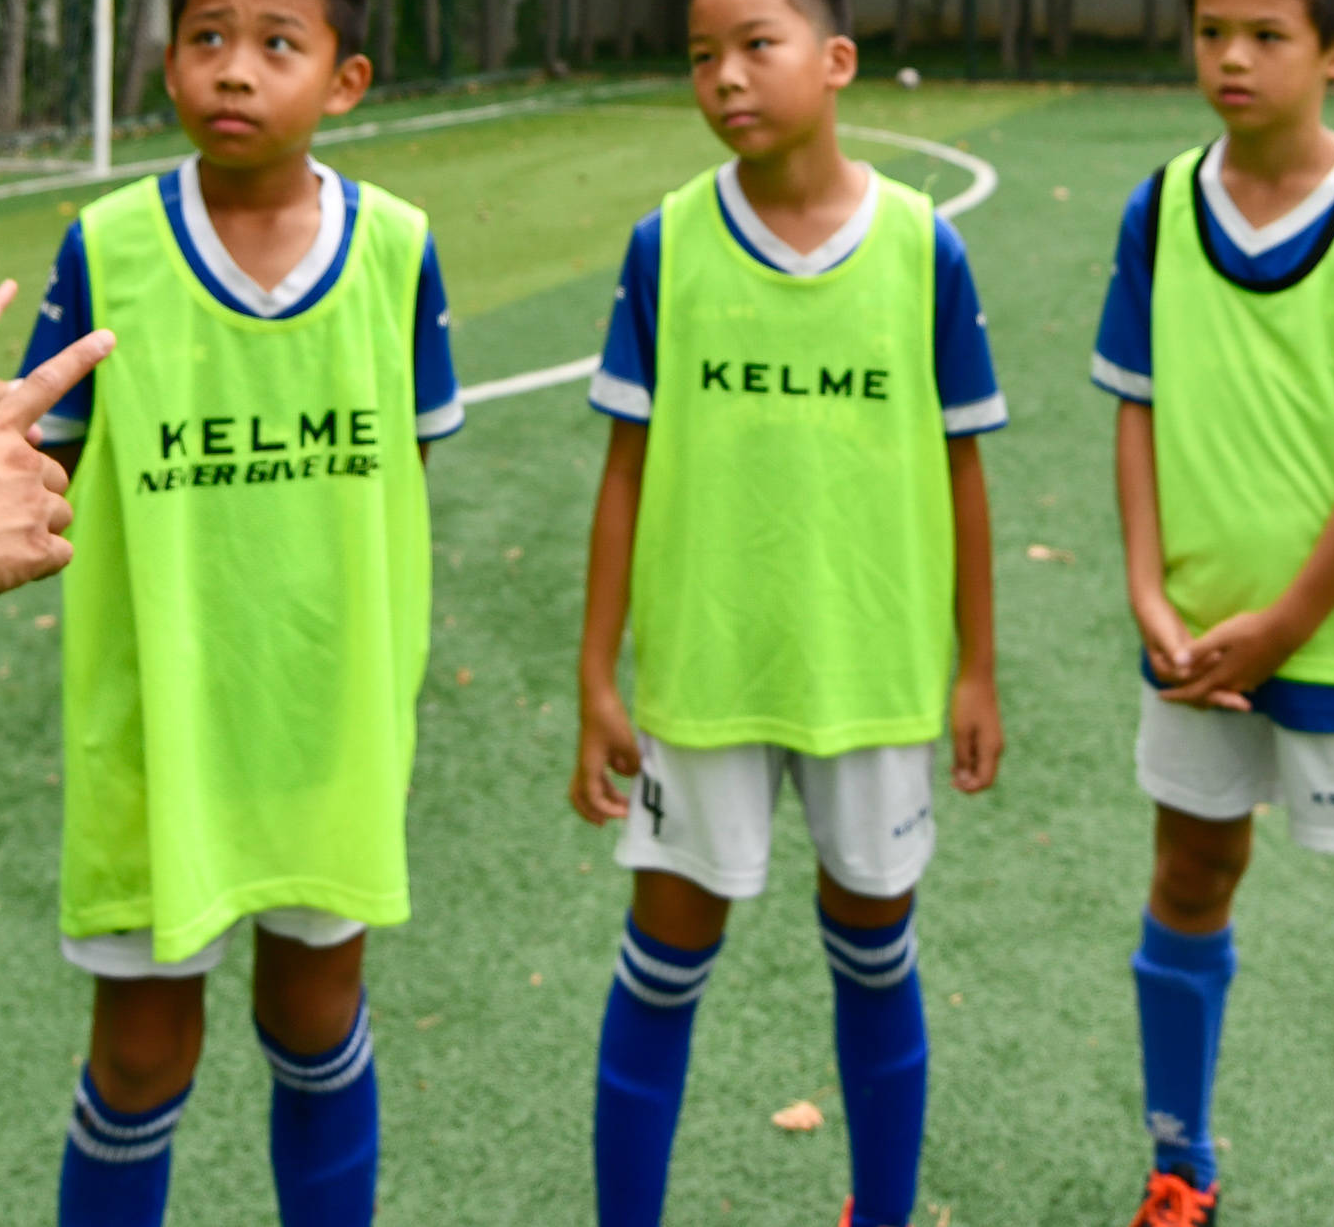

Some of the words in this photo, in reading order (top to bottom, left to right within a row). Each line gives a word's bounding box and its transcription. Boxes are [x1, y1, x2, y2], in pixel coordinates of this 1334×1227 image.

[700, 359, 889, 401] KELME
[160, 409, 379, 459] KELME
[136, 464, 237, 495] NEER
